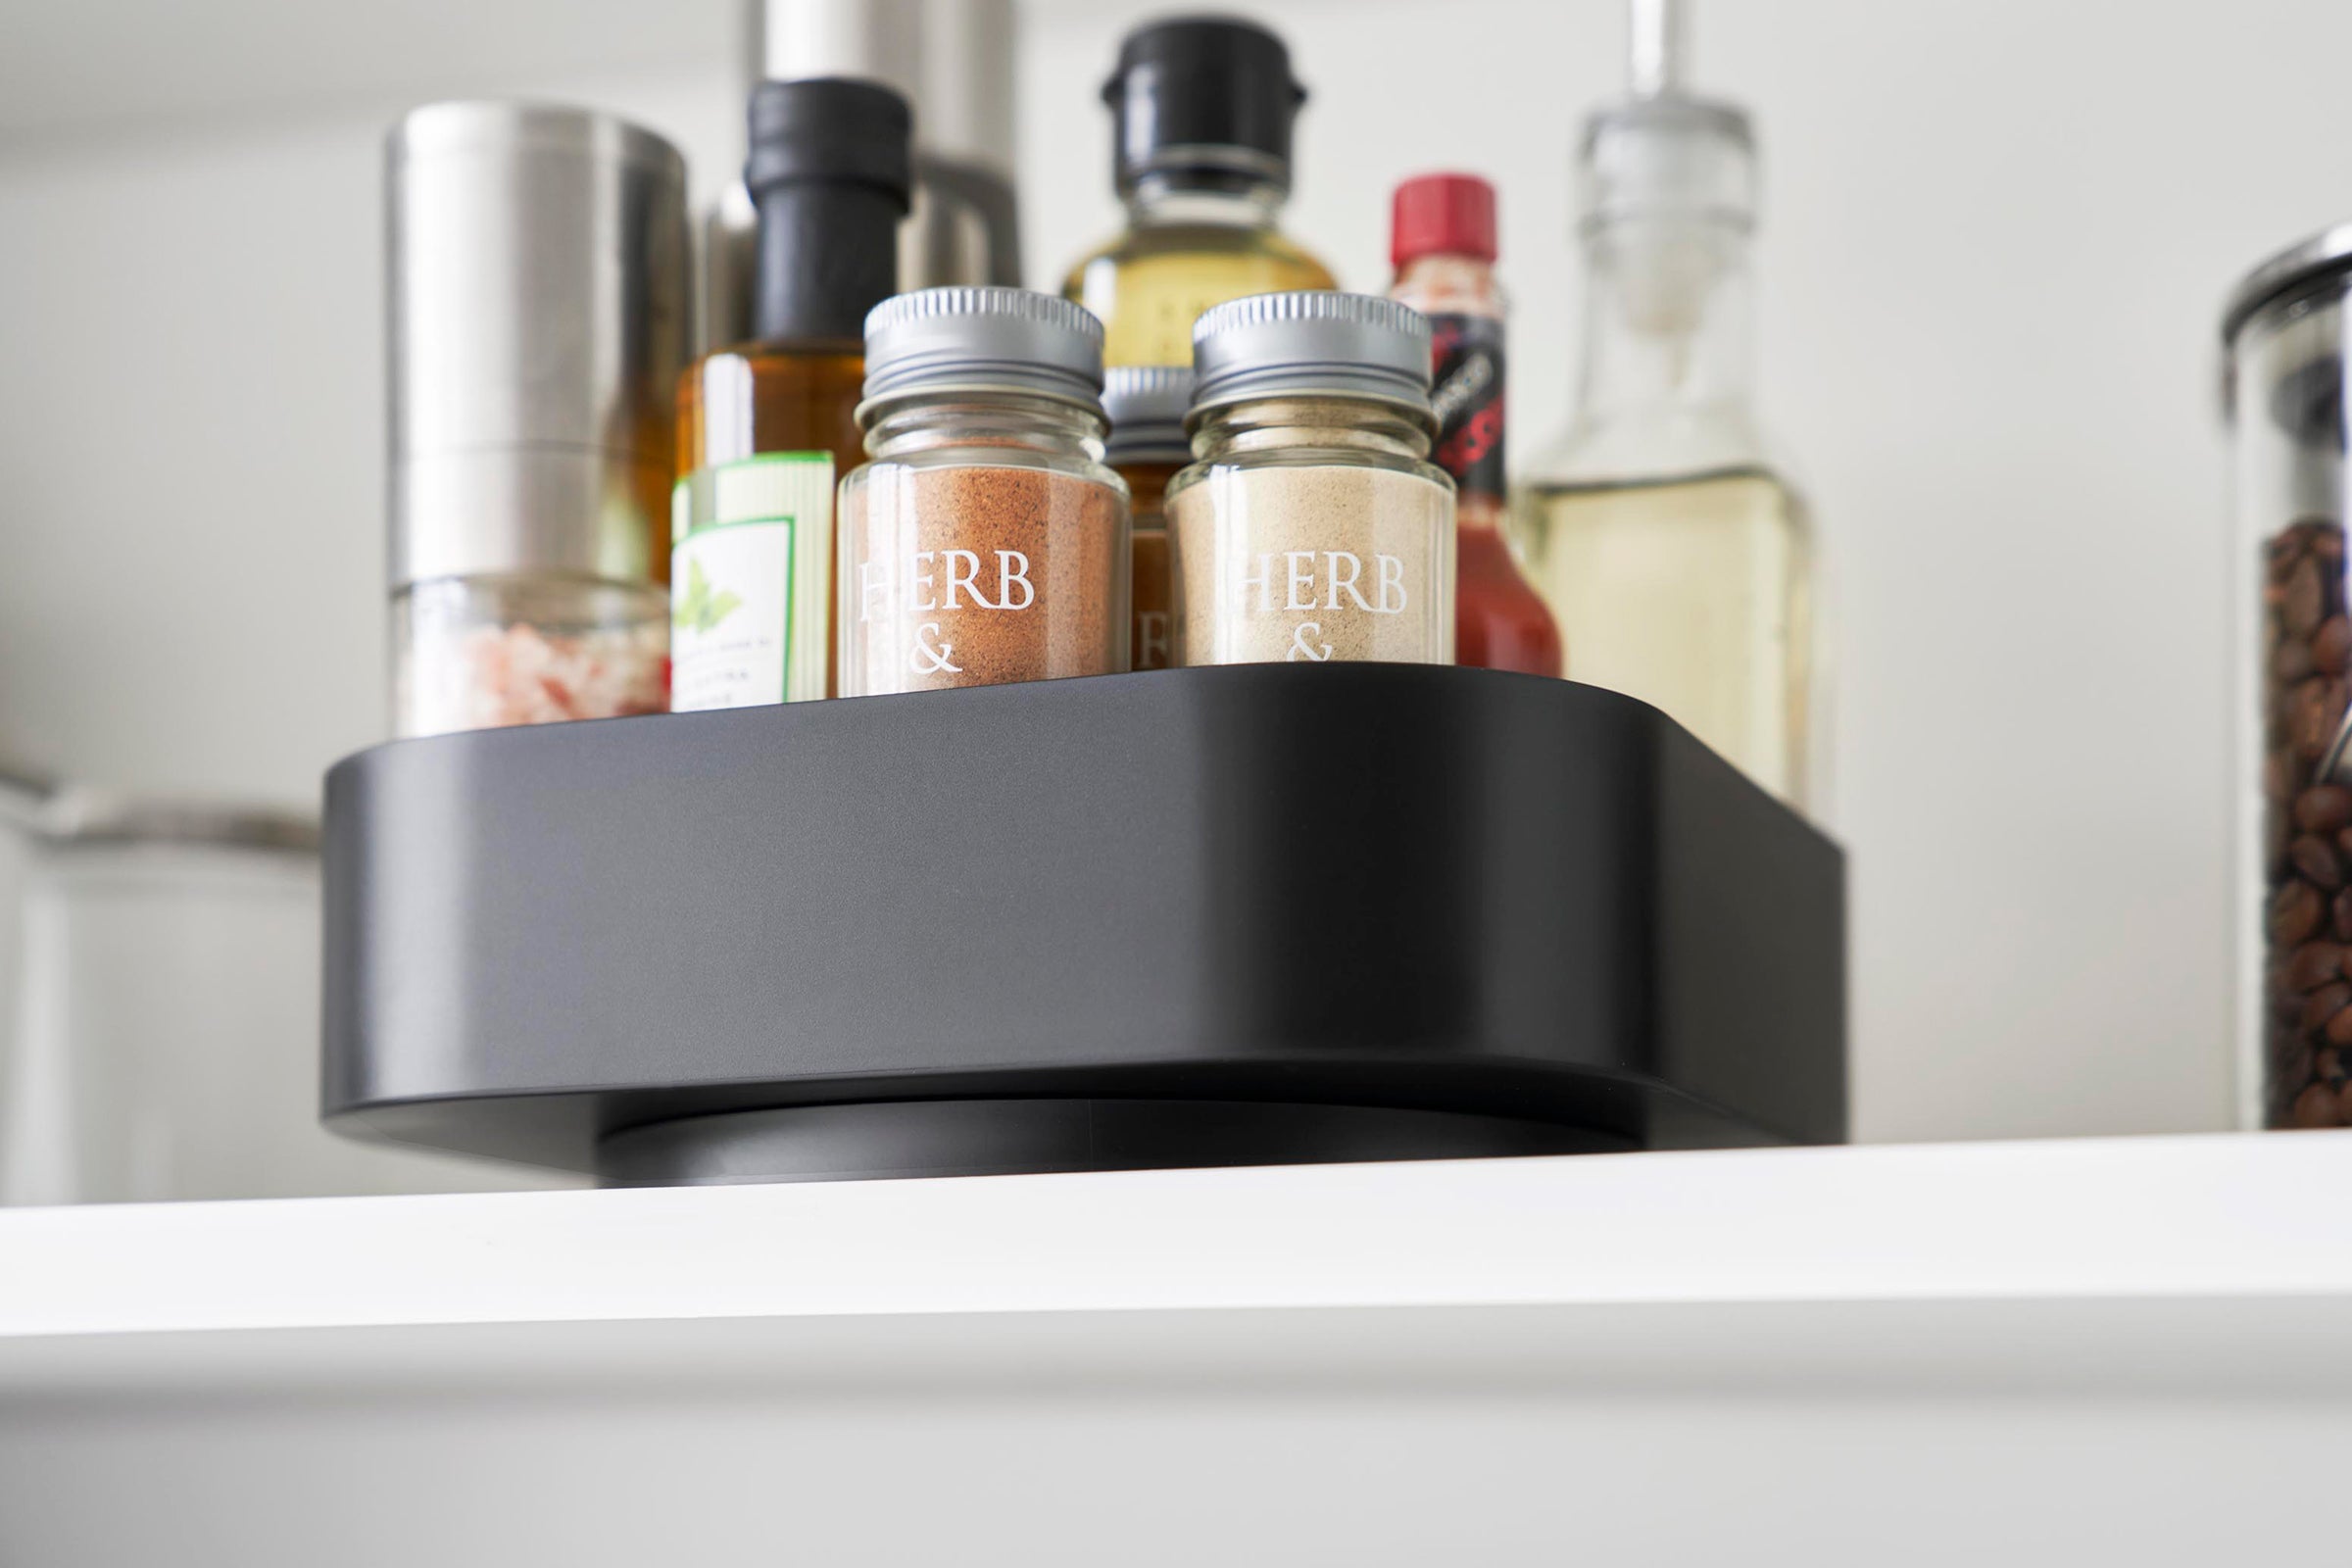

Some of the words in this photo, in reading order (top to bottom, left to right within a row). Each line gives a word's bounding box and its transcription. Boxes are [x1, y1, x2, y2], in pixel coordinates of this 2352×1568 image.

[859, 550, 1035, 622] HERB
[1227, 550, 1407, 614] HERB
[908, 622, 963, 675] &
[1286, 621, 1333, 662] &
